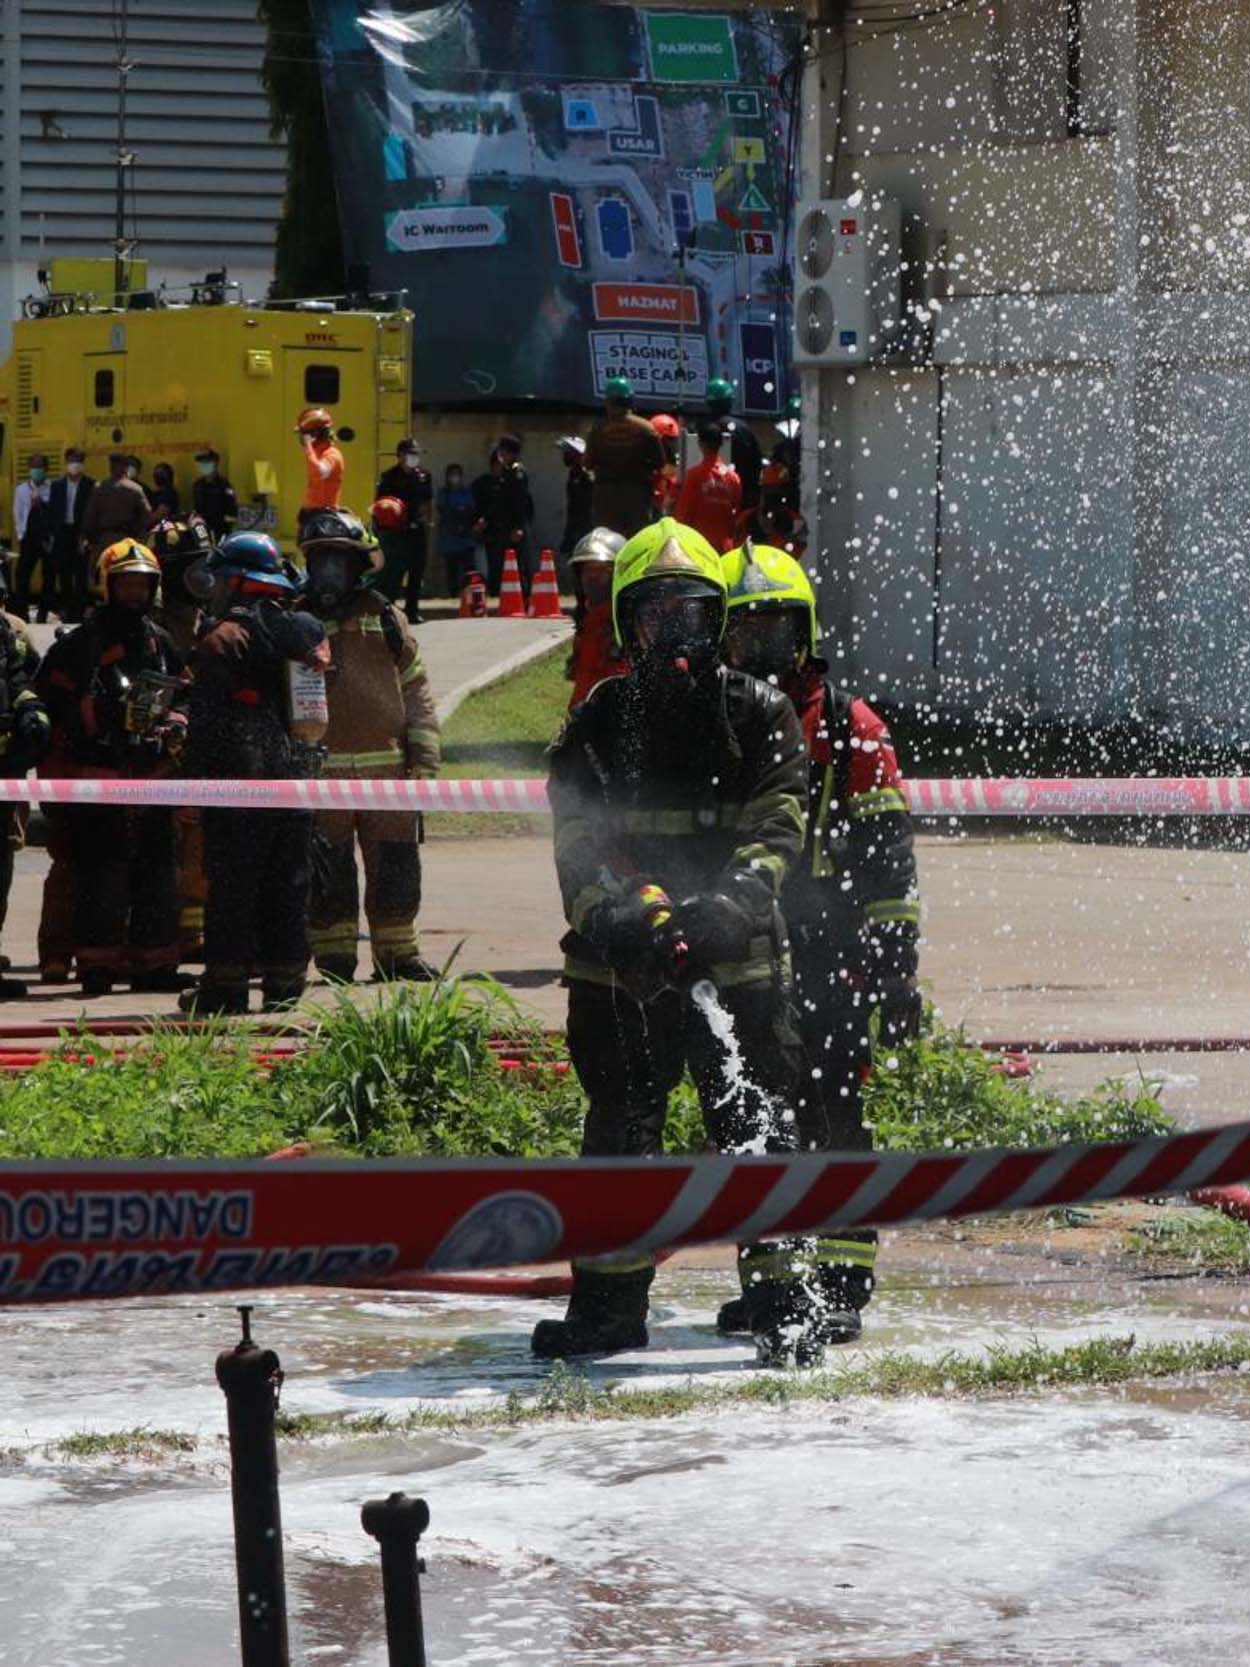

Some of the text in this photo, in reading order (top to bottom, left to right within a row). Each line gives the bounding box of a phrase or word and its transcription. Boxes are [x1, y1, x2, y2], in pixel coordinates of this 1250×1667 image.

[657, 42, 723, 55] PARKING
[615, 136, 656, 151] USAR
[403, 222, 489, 237] IC Warroom
[617, 295, 678, 311] HAZMAT
[608, 345, 678, 361] STAGING
[745, 358, 773, 374] ICP
[605, 366, 697, 383] BASE CAMP
